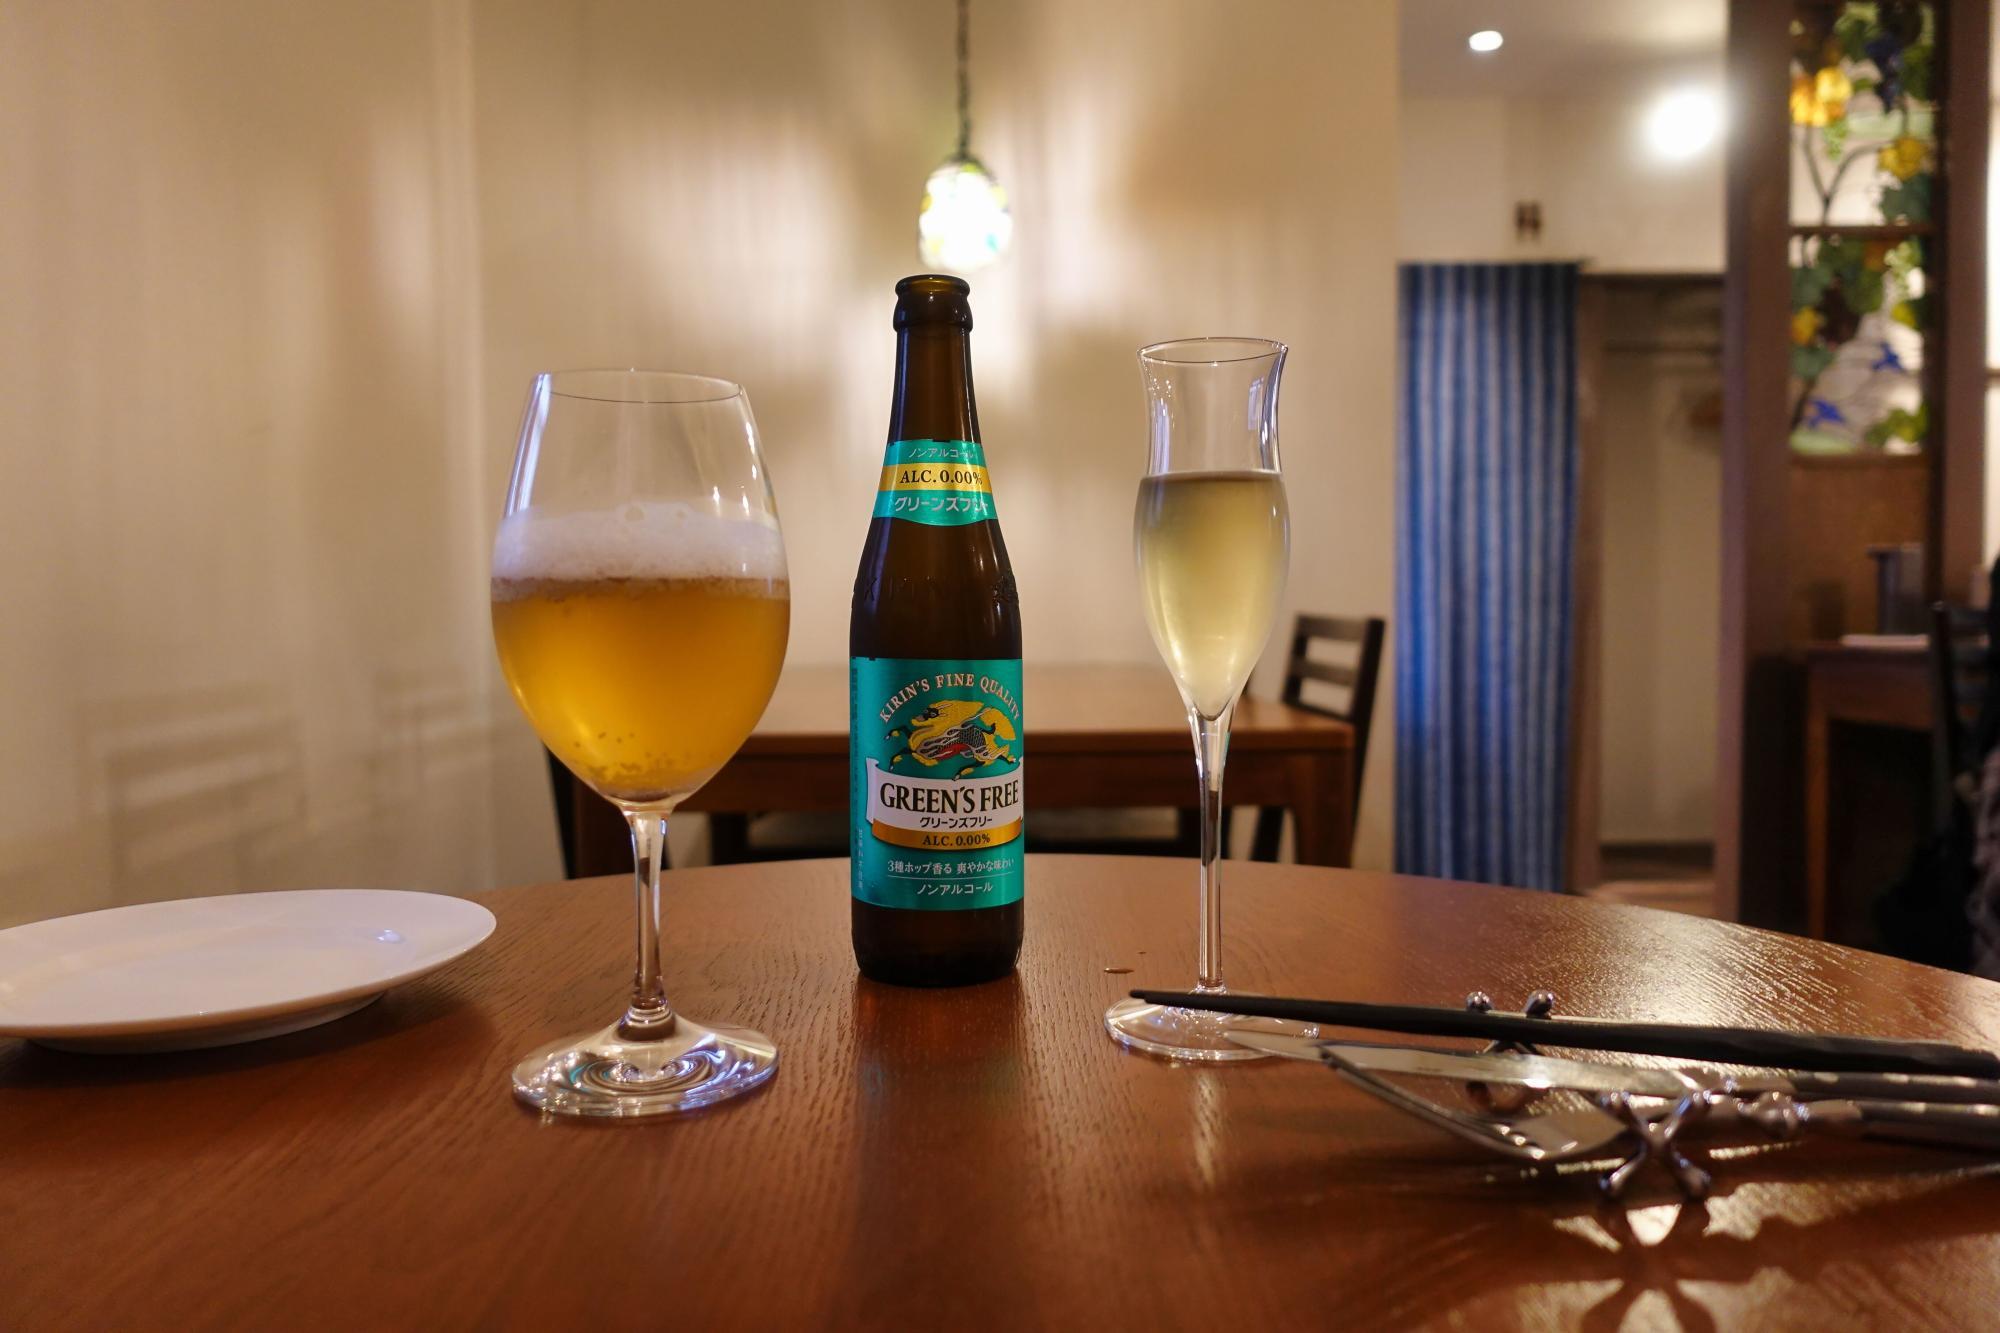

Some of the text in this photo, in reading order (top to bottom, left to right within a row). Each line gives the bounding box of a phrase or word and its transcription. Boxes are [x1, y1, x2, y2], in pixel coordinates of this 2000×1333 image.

[908, 448, 974, 459] ノンアルコール
[895, 496, 989, 513] グリーンズフリー
[879, 673, 1020, 722] KIRIN'S FINE QUALITY
[880, 780, 1018, 813] GREEN'S FREE
[919, 816, 993, 830] グリーンズフリー
[916, 882, 993, 896] ノンアルコール
